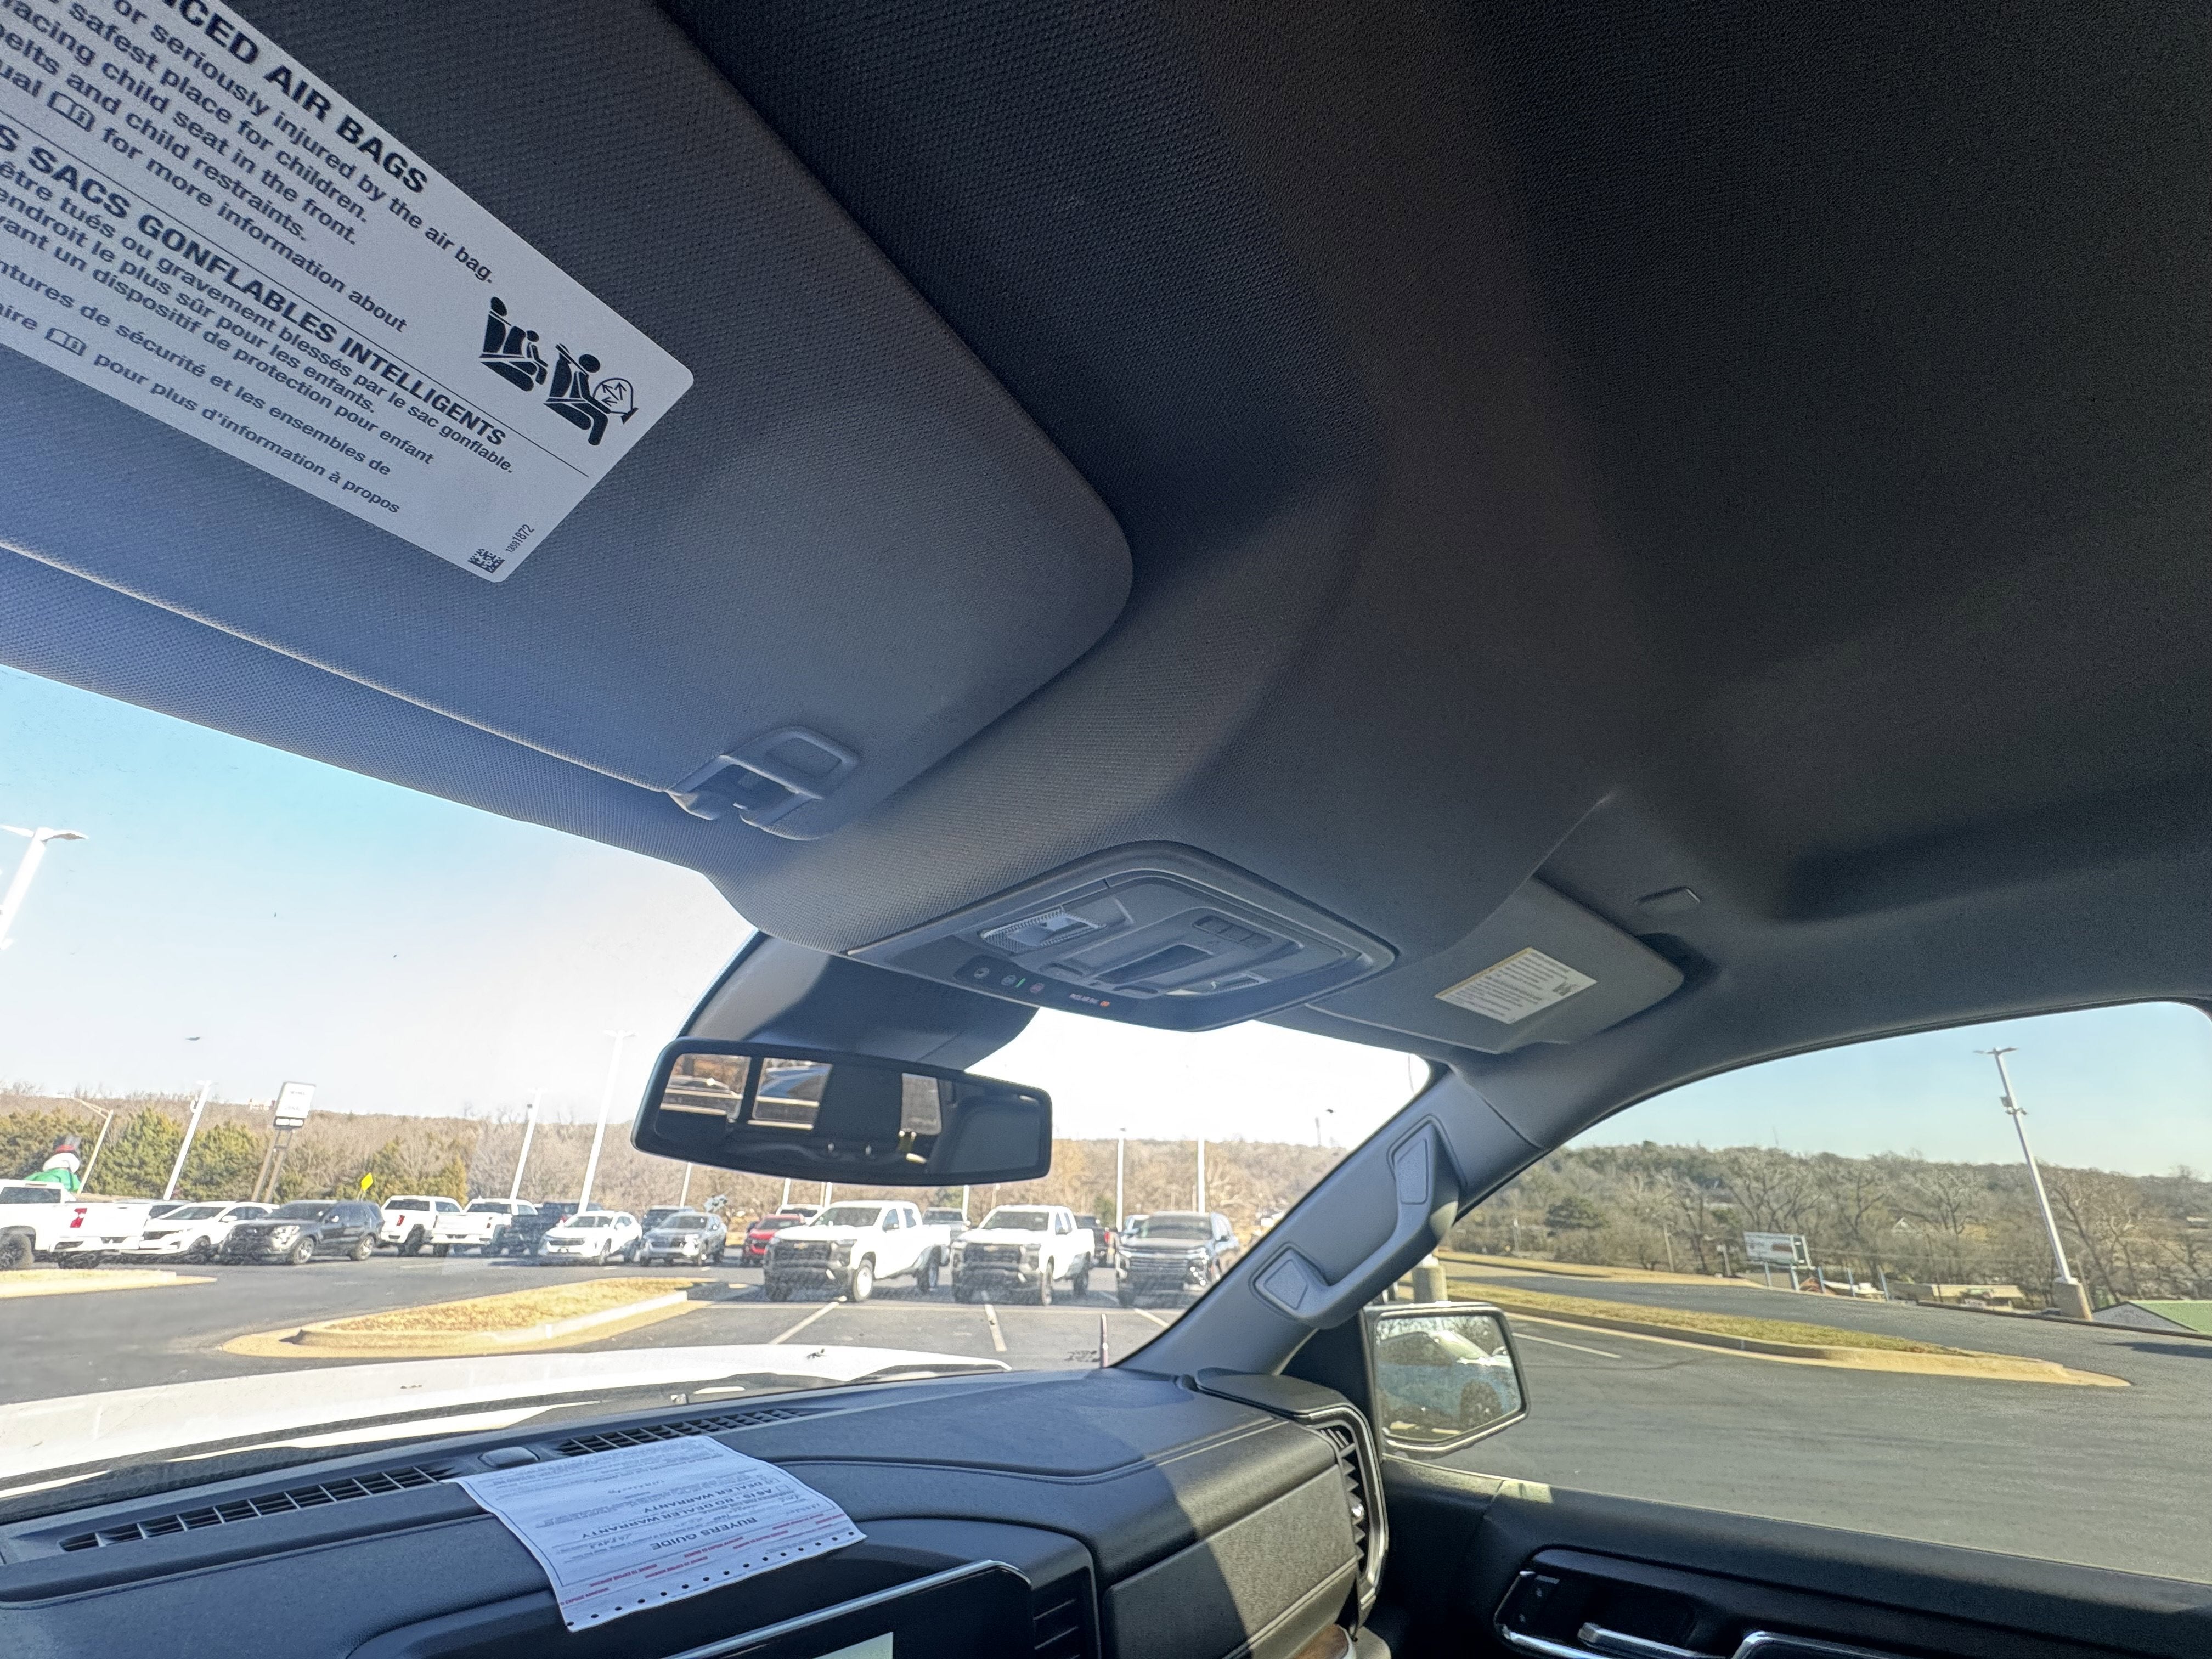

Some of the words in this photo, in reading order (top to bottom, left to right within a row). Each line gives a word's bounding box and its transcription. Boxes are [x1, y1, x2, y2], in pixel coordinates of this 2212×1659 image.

[66, 73, 122, 115] and
[126, 113, 191, 161] child
[193, 158, 306, 241] restraints.
[69, 3, 159, 73] safest
[160, 68, 232, 124] place
[237, 120, 274, 150] for
[275, 150, 366, 222] children.
[101, 63, 170, 114] child
[172, 111, 229, 156] seat
[231, 149, 256, 174] in
[261, 169, 298, 202] the
[302, 198, 355, 245] front.
[114, 0, 148, 24] or
[150, 24, 270, 117] seriously
[273, 111, 357, 180] injured
[357, 174, 387, 202] by
[389, 198, 422, 229] the
[425, 228, 454, 250] air
[455, 246, 492, 283] bag.
[263, 65, 332, 123] AIR
[335, 115, 427, 193] BAGS
[28, 146, 131, 218] SACS
[138, 215, 337, 343] GONFLABLES
[340, 337, 506, 445] INTELLIGENTS
[101, 128, 143, 159] for
[146, 158, 213, 207] more
[217, 202, 345, 293] information
[348, 291, 407, 332] about
[0, 161, 53, 201] être
[60, 197, 116, 238] tués
[121, 236, 153, 260] ou
[156, 258, 276, 332] gravement
[278, 326, 352, 377] blessés
[353, 374, 387, 396] par
[388, 392, 406, 408] le
[408, 406, 438, 427] sac
[439, 426, 512, 473] gonflable.
[54, 247, 87, 272] un
[93, 269, 202, 333] dispositif
[203, 331, 230, 351] de
[233, 349, 332, 408] protection
[334, 405, 378, 431] pour
[380, 431, 433, 464] enfant
[80, 306, 110, 326] de
[115, 325, 206, 377] sécurité
[210, 376, 232, 392] et
[235, 386, 266, 409] les
[269, 407, 365, 462] ensembles
[369, 460, 390, 475] de
[91, 241, 115, 262] le
[119, 260, 172, 295] plus
[176, 293, 215, 317] sûr
[216, 316, 268, 348] pour
[269, 344, 300, 368] les
[304, 366, 374, 413] enfants.
[94, 354, 149, 384] pour
[150, 383, 198, 410] plus
[202, 409, 325, 476] d'information
[328, 472, 341, 483] à
[342, 481, 399, 512] propos
[583, 1516, 660, 1538] WARRANTY
[645, 1493, 714, 1513] WARRANTY
[650, 1533, 697, 1550] GUIDE
[661, 1504, 713, 1519] DEALER
[700, 1517, 758, 1536] BUYERS
